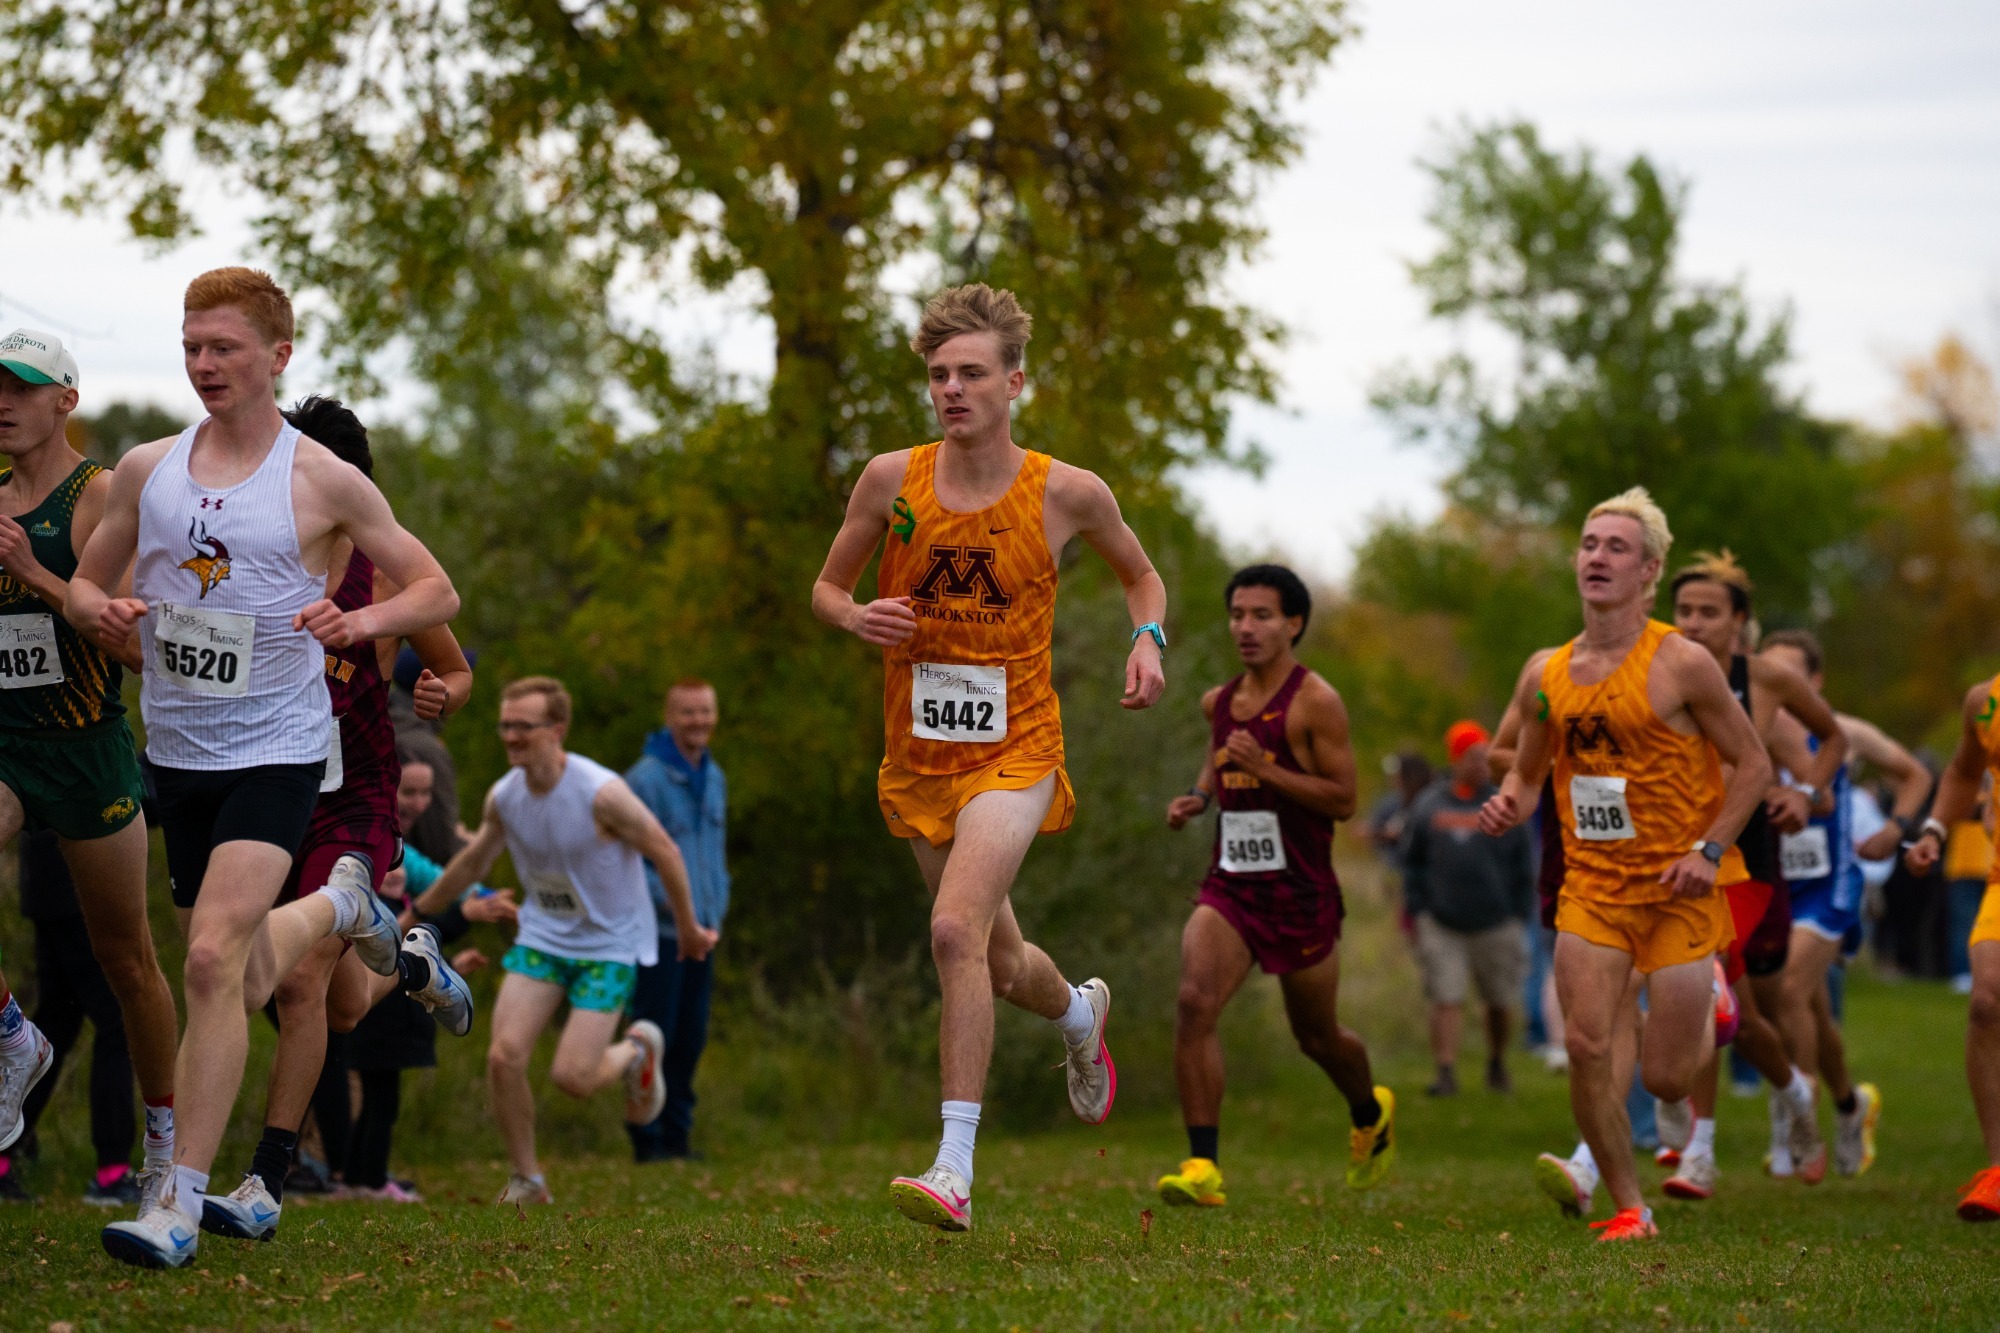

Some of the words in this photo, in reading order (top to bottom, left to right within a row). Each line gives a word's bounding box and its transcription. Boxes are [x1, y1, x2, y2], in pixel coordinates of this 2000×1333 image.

[13, 335, 46, 351] DAKOTA
[912, 604, 1007, 625] CROOKSTON
[12, 628, 47, 643] TIMING
[207, 626, 243, 647] TIMING
[163, 640, 238, 684] 5520
[962, 680, 997, 695] TIMING
[923, 698, 994, 731] 5442
[1577, 805, 1624, 831] 5438
[1228, 838, 1275, 862] 5499
